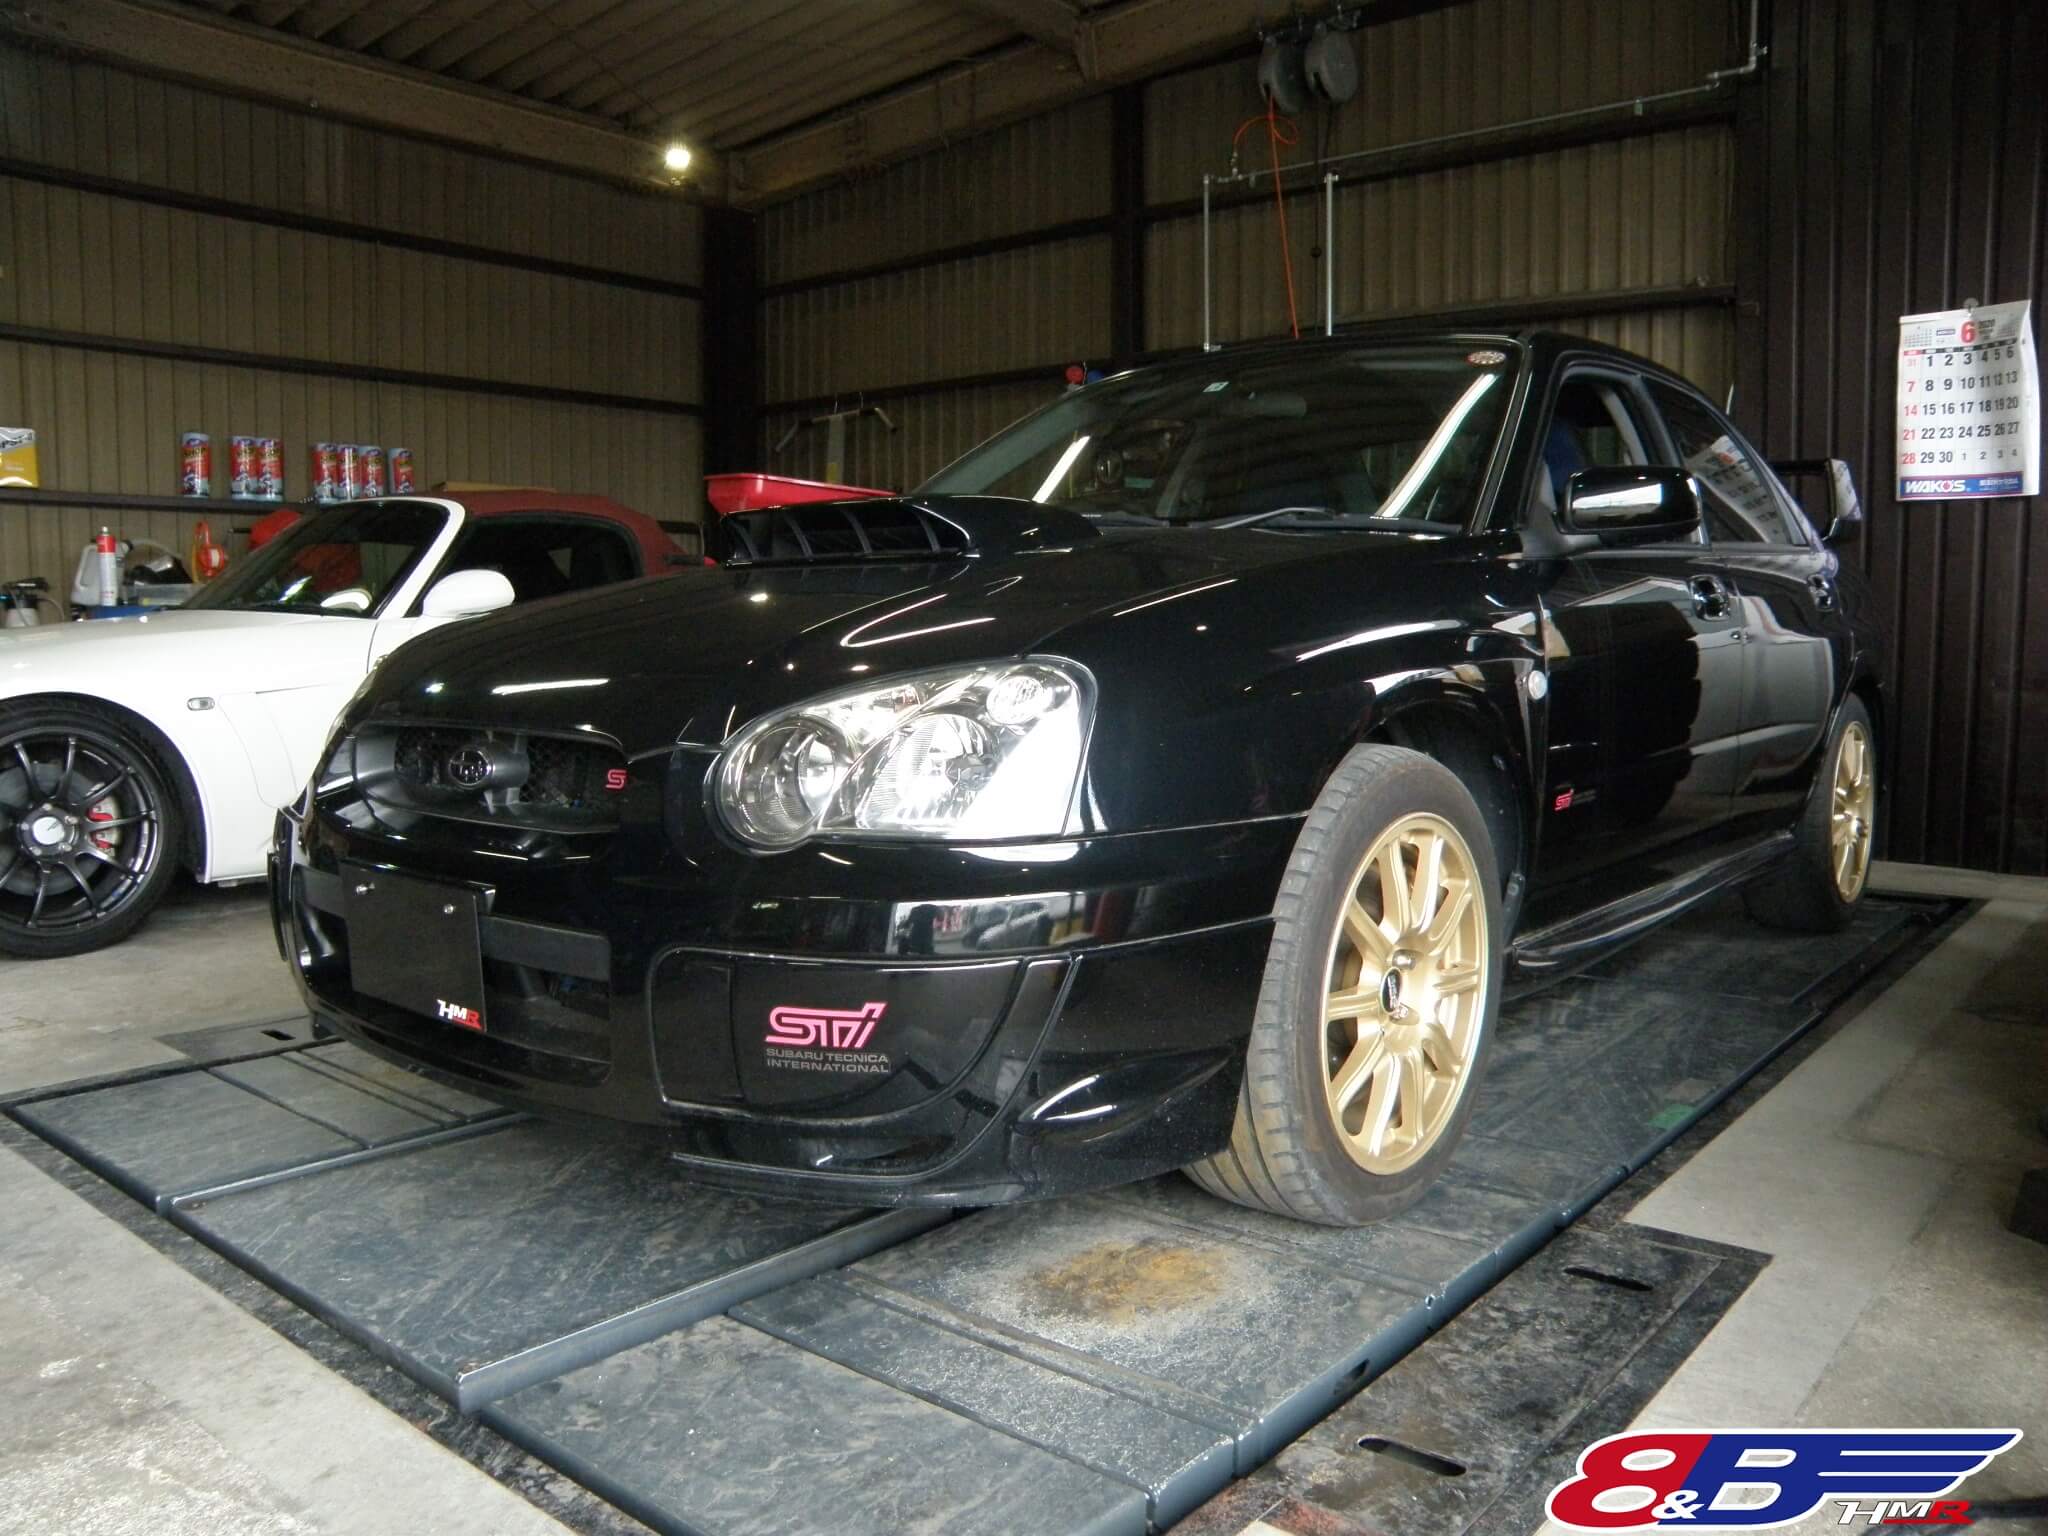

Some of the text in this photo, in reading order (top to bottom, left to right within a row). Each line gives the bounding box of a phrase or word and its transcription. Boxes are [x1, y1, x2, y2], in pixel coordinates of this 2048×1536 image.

[1961, 321, 1976, 343] 6
[1927, 356, 1932, 367] 1
[1945, 354, 1953, 366] 2
[1964, 353, 1972, 364] 3
[1982, 350, 1988, 362] 4
[1995, 349, 2000, 360] 5
[2007, 347, 2014, 358] 6
[1908, 381, 1915, 392] 7
[1926, 380, 1933, 391] 8
[1944, 379, 1952, 390] 9
[1961, 378, 1974, 389] 10
[1980, 376, 1990, 387] 11
[2007, 372, 2017, 383] 13
[1905, 405, 1917, 415] 14
[1923, 404, 1936, 415] 15
[1942, 403, 1954, 414] 16
[1960, 402, 1973, 413] 17
[1979, 400, 1991, 412] 18
[2007, 397, 2018, 408] 20
[1903, 422, 2019, 440] 21 22 23 24 25 26 27
[1902, 453, 1915, 464] 28
[1921, 452, 1934, 463] 29
[1939, 452, 1952, 462] 30
[437, 999, 482, 1029] HMR
[766, 1048, 889, 1063] SUBARU TECNICA
[767, 1058, 889, 1073] INTERNATIONAL
